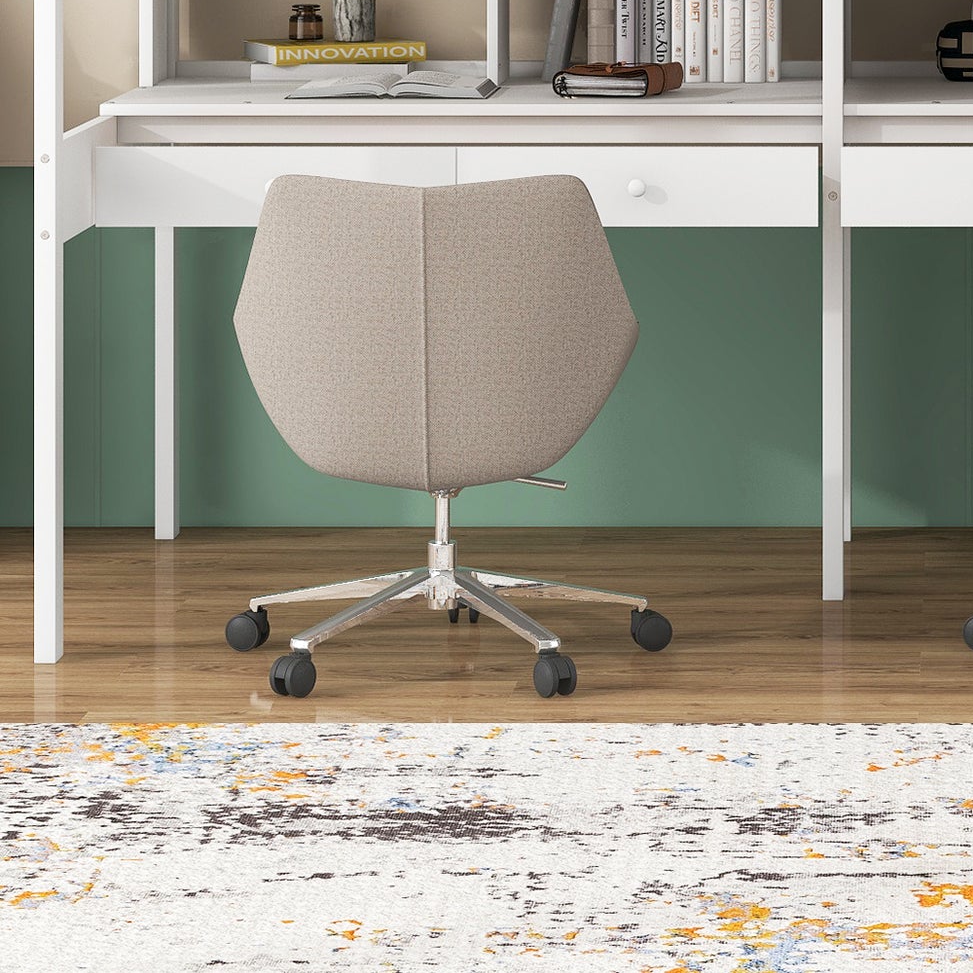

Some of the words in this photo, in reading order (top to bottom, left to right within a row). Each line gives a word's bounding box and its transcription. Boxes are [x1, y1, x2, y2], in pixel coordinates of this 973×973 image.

[690, 1, 700, 23] DIET
[621, 12, 630, 38] TWIST
[730, 6, 742, 65] CHANEL
[278, 45, 426, 61] INNOVATION
